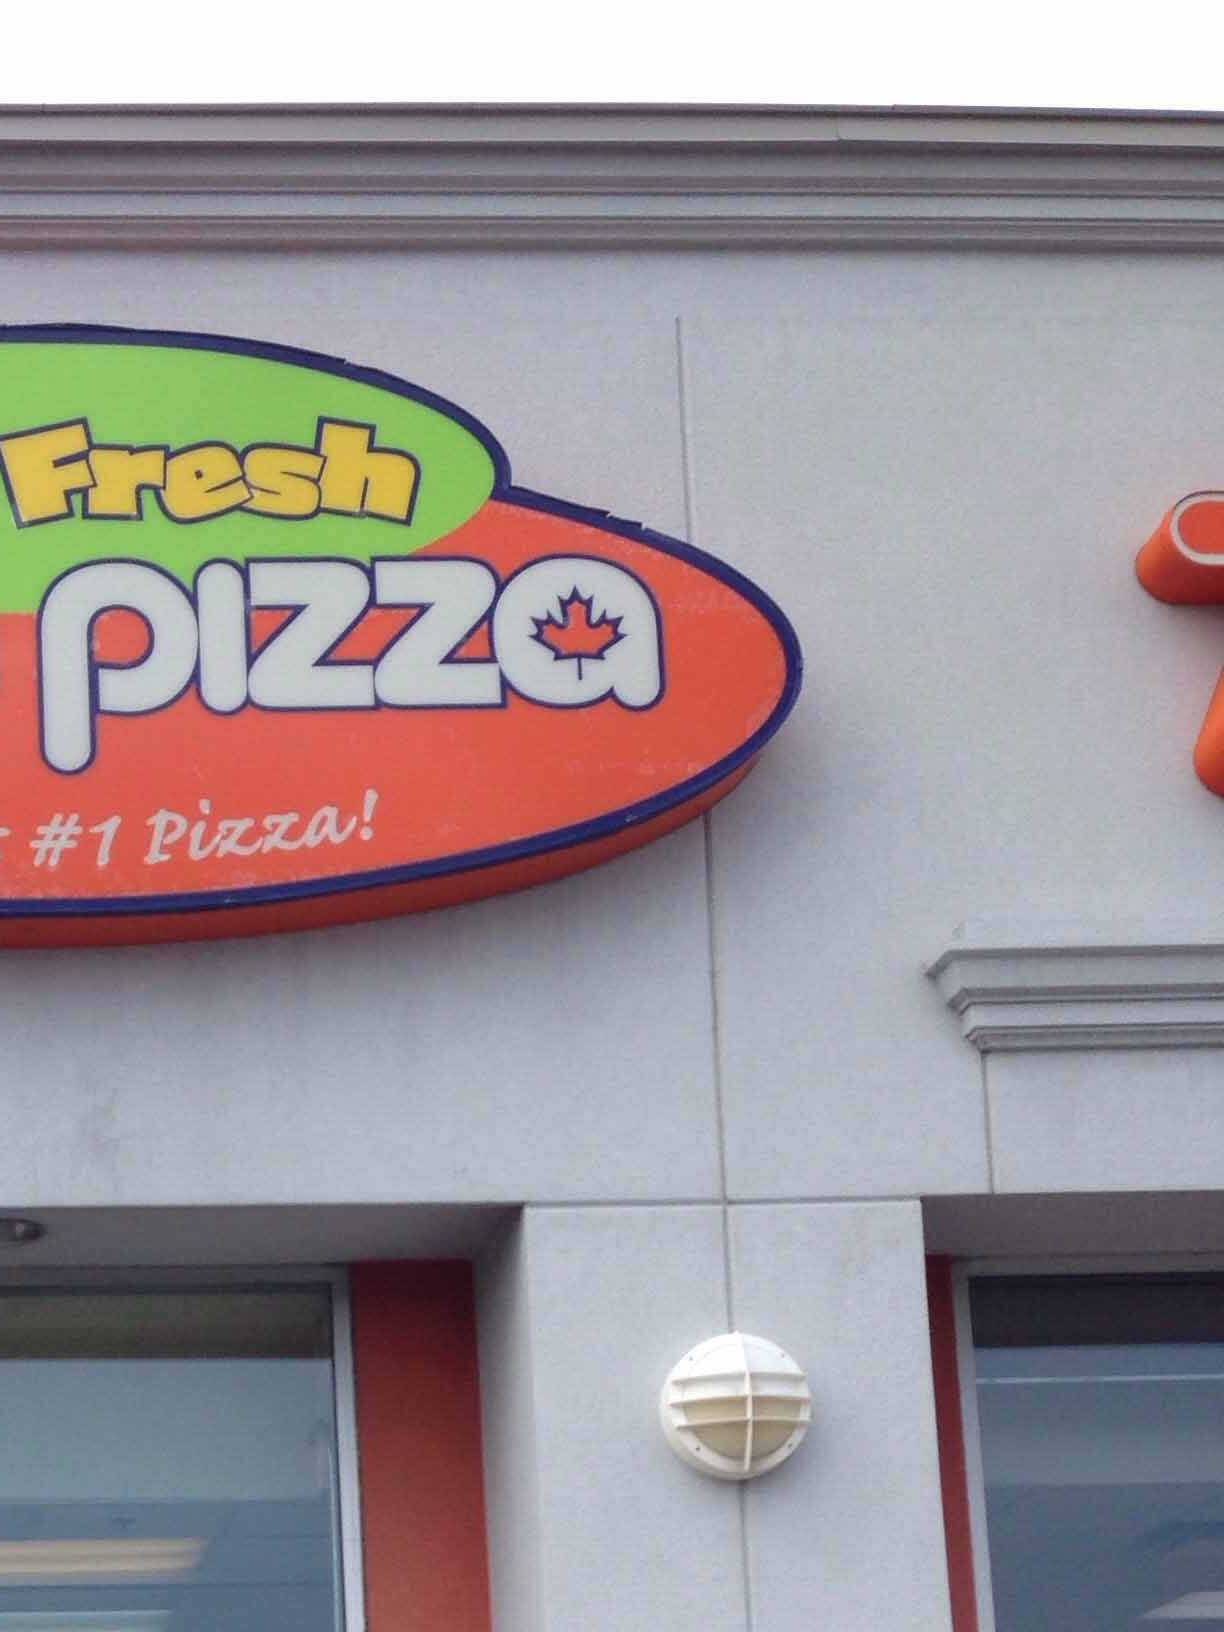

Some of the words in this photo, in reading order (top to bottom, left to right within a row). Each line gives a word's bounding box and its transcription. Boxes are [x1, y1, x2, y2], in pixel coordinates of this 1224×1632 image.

[36, 553, 666, 775] pizza
[29, 808, 122, 867] #1
[143, 789, 379, 867] Pizza!
